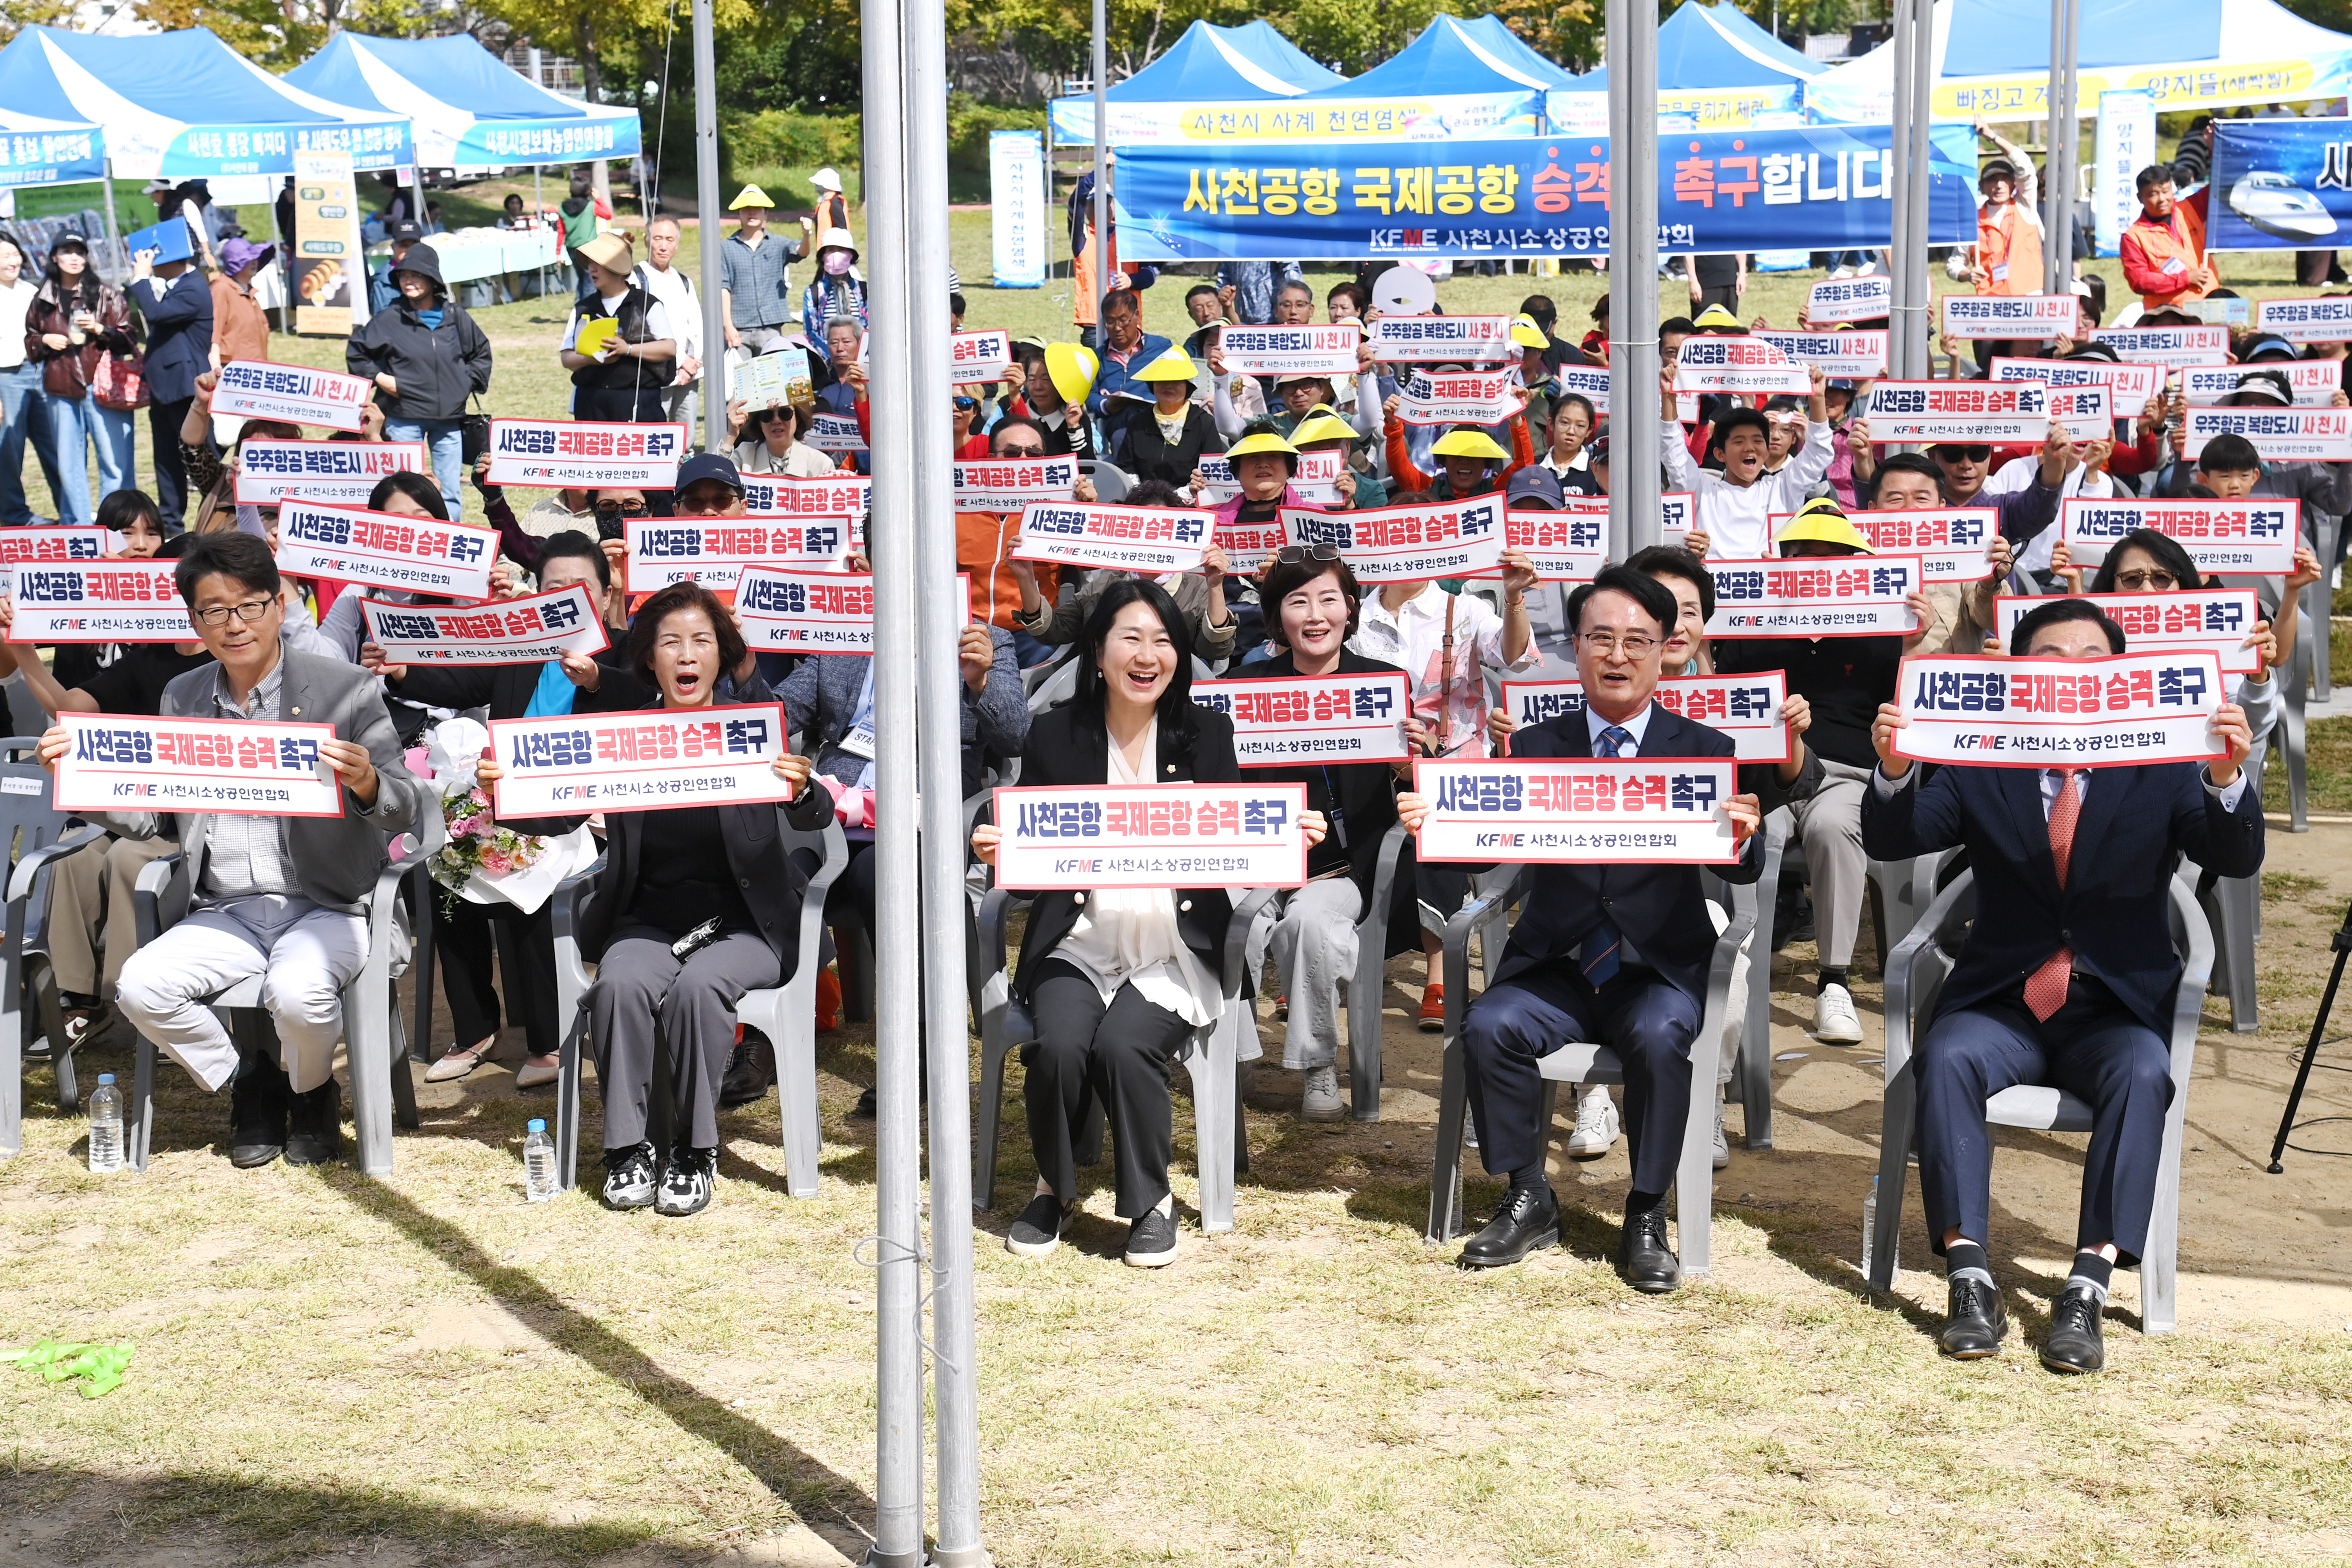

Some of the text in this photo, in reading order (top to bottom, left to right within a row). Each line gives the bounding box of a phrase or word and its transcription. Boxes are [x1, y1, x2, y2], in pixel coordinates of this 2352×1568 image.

[1957, 87, 2023, 111] 빠징고
[1195, 113, 1258, 133] 사천시
[1273, 112, 1314, 132] 사계
[1182, 150, 1893, 216] 사천공항 국제공항 승격 촉구합니다
[1370, 229, 1437, 247] KFME
[1815, 286, 1850, 301] 우주항공
[1950, 302, 2031, 317] 우주항공 복합도시
[1382, 322, 1465, 338] 우주항공 복합도시
[2140, 334, 2181, 348] 복합도시
[954, 338, 999, 360] 승격 촉구
[1226, 333, 1311, 350] 우주항공 복합도시
[1797, 338, 1838, 354] 복합도시
[1681, 344, 1765, 364] 사천공항 국제공항
[223, 364, 310, 395] 우주항공 복합도시
[1435, 379, 1482, 398] 국제공항
[1870, 389, 2044, 412] 사천공항 국제공항 승격 촉구
[2077, 394, 2100, 414] 촉구
[1409, 409, 1432, 417] KFME
[1894, 425, 2020, 434] KFME 사천시소상공인연합회
[2196, 416, 2299, 434] 우주항공 복합도시
[499, 429, 673, 456] 사천공항 국제공항 승격 촉구
[246, 449, 361, 472] 우주항공 복합도시
[523, 467, 648, 479] KFME 사천시소상공인연합회
[966, 465, 1070, 487] 국제공항 승격 촉구
[270, 487, 300, 495] KFME
[777, 487, 860, 512] 국제공항 승격
[1029, 509, 1204, 543] 사천공항 국제공항 승격 촉구
[1355, 506, 1492, 547] 국제공항 승격 촉구
[1539, 522, 1600, 547] 승격 촉구
[1916, 519, 1983, 546] 승격 촉구
[2214, 511, 2283, 537] 승격 촉구
[288, 512, 484, 562] 사천공항 국제공항 승격 촉구
[640, 527, 837, 556] 사천공항 국제공항 승격 촉구
[1048, 545, 1174, 564] KFME 사천시소상공인연합회
[1360, 554, 1467, 573] 사천시소상공인연합회
[310, 557, 449, 585] KFME 사천시소상공인연합회
[20, 572, 151, 600] 사천공항 국제공항
[1768, 568, 1909, 598] 국제공항 승격 촉구
[743, 579, 805, 612] 사천공항
[51, 619, 87, 629] KFME
[376, 598, 579, 638] 사천공항 국제공항 승격 촉구
[1729, 613, 1876, 626] KFME 사천시소상공인연합회
[2165, 602, 2242, 633] 승격 촉구
[770, 629, 808, 640] KFME
[1914, 667, 2206, 713] 사천공항 국제공항 승격 촉구
[1235, 687, 1392, 723] 국제공항 승격 촉구
[1686, 688, 1770, 719] 승격 촉구
[77, 729, 319, 770] 사천공항 국제공항 승격 촉구
[512, 719, 768, 768] 사천공항 국제공항 승격 촉구
[855, 733, 875, 747] STAF
[1239, 738, 1361, 753] 사천시소상공인연합회
[1954, 732, 2165, 751] KFME 사천시소상공인연합회
[114, 783, 289, 801] KFME 사천시소상공인연합회
[553, 776, 735, 800] KFME 사천시소상공인연합회
[1437, 774, 1716, 811] 사천공항 국제공항 승격 촉구
[1017, 799, 1286, 837] 사천공항 국제공항 승격 촉구
[1476, 833, 1676, 847] KFME 사천시소상공인연합회
[1055, 858, 1248, 872] KFME 사천시소상공인연합회
